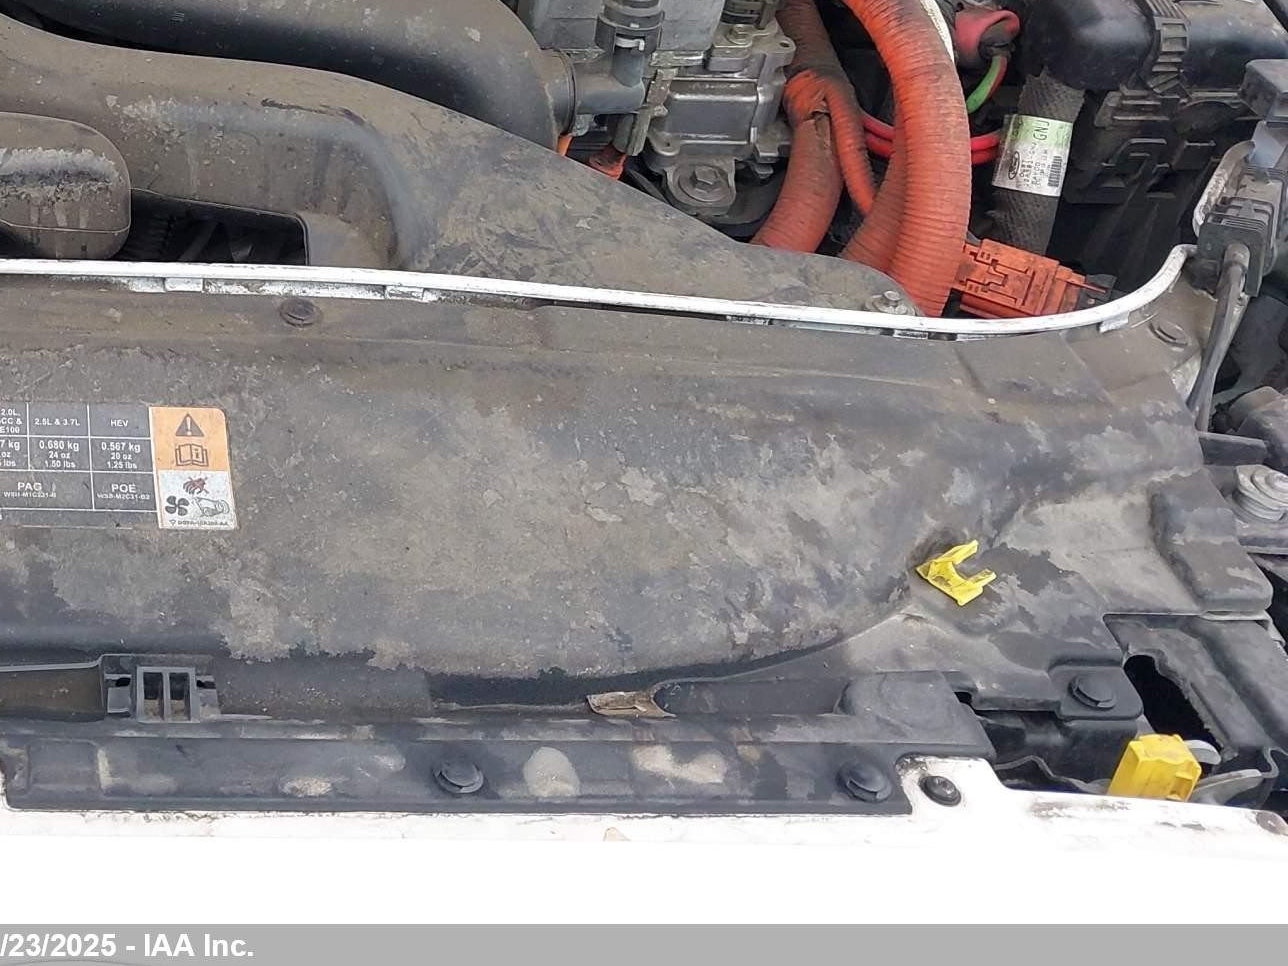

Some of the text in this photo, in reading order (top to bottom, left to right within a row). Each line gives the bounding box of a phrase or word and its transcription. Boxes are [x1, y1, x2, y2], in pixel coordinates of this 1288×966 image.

[54, 418, 61, 426] &
[110, 419, 129, 427] HEV
[8, 439, 20, 451] kg
[39, 440, 79, 452] 0.680 kg
[101, 442, 141, 453] 0.567 kg
[48, 451, 59, 459] 24
[3, 459, 16, 467] lbs
[45, 460, 76, 468] 1.50 lbs
[107, 461, 137, 469] 1.25 lbs
[17, 482, 42, 491] PAG
[111, 483, 137, 493] POE
